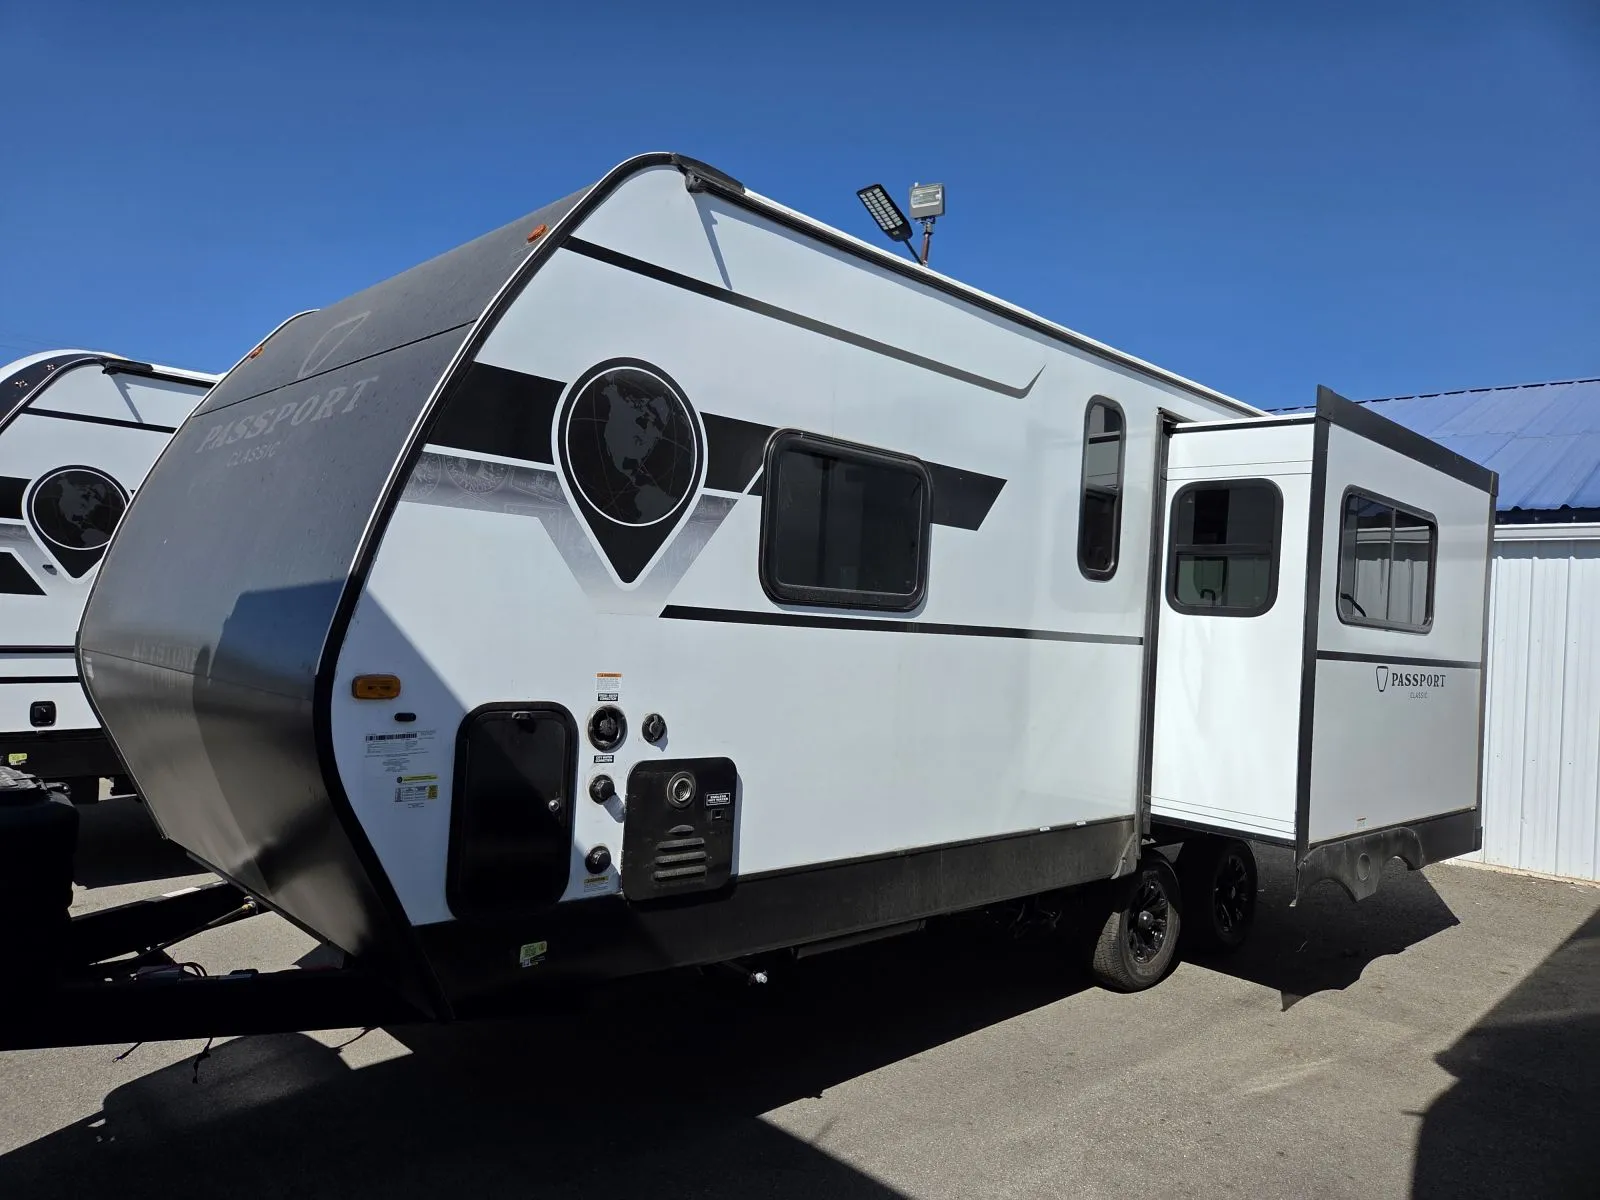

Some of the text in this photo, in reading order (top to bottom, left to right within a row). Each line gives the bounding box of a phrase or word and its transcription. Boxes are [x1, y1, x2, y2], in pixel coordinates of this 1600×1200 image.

[195, 376, 380, 454] PASSPORT
[226, 441, 281, 468] CLASSIC
[1392, 673, 1446, 688] PASSPORT
